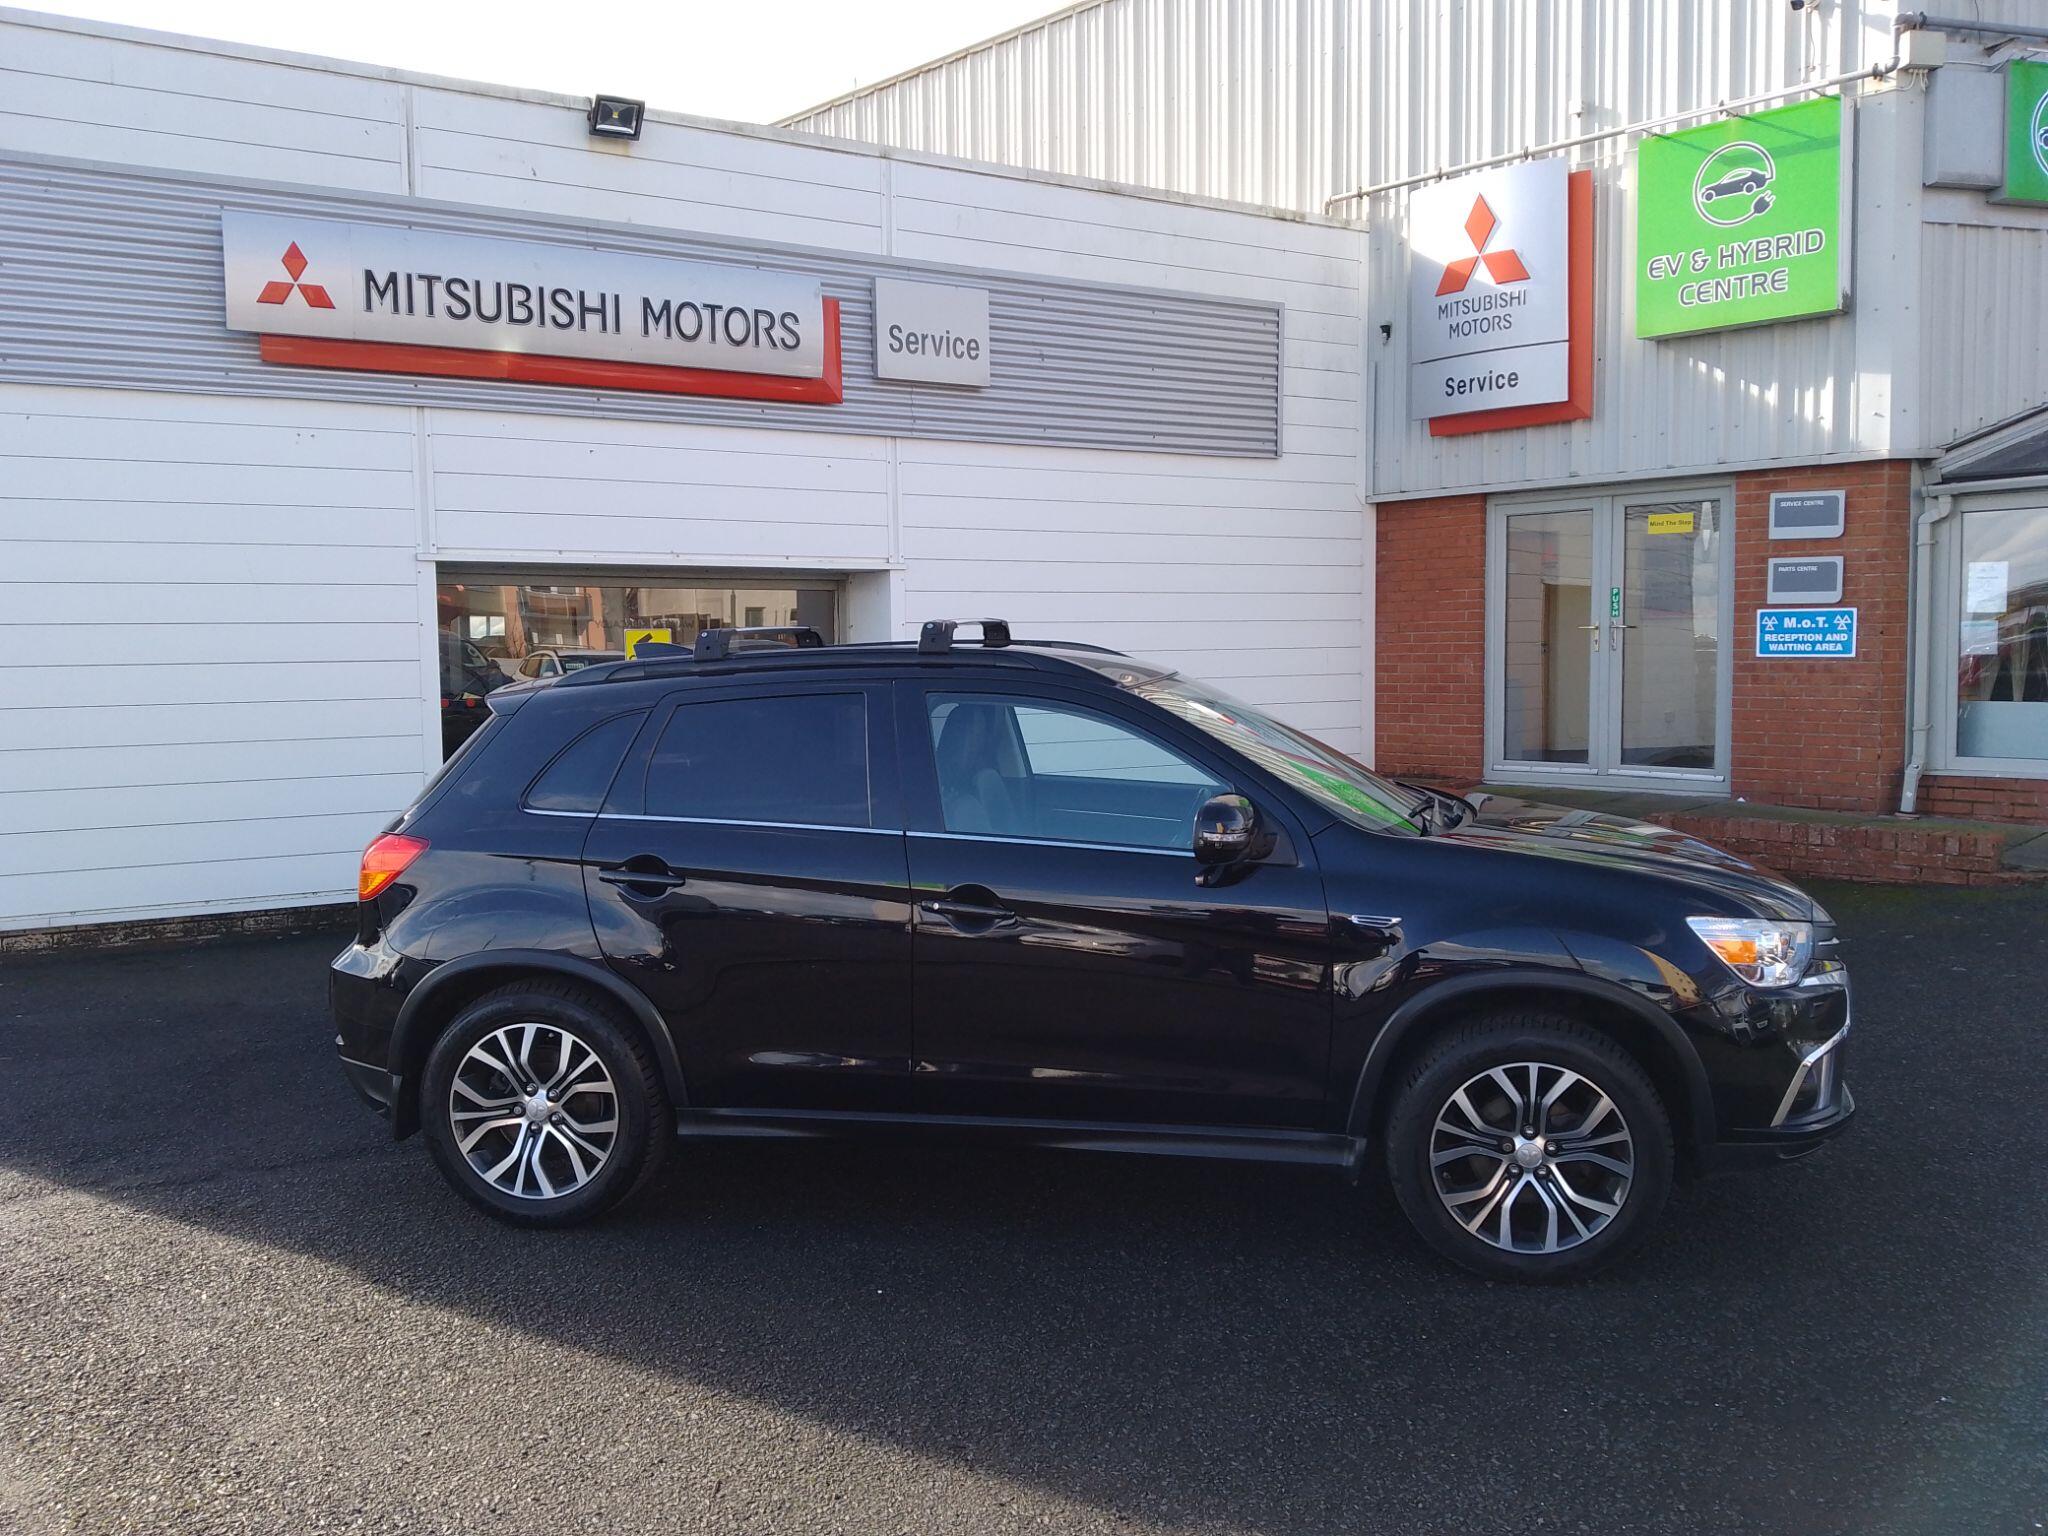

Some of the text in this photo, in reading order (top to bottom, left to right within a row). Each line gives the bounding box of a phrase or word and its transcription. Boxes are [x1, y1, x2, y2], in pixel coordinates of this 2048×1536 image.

[1647, 229, 1825, 281] EV & HYBRID
[1679, 268, 1788, 307] CENTRE
[363, 268, 802, 352] MITSUBISHI MOTORS
[1437, 289, 1527, 320] MITSUBISHI
[1448, 312, 1514, 340] MOTORS
[887, 324, 981, 361] Service
[1444, 367, 1520, 397] Service
[1764, 632, 1849, 642] RECEPTION AND
[1768, 642, 1843, 652] WAITING AREA
